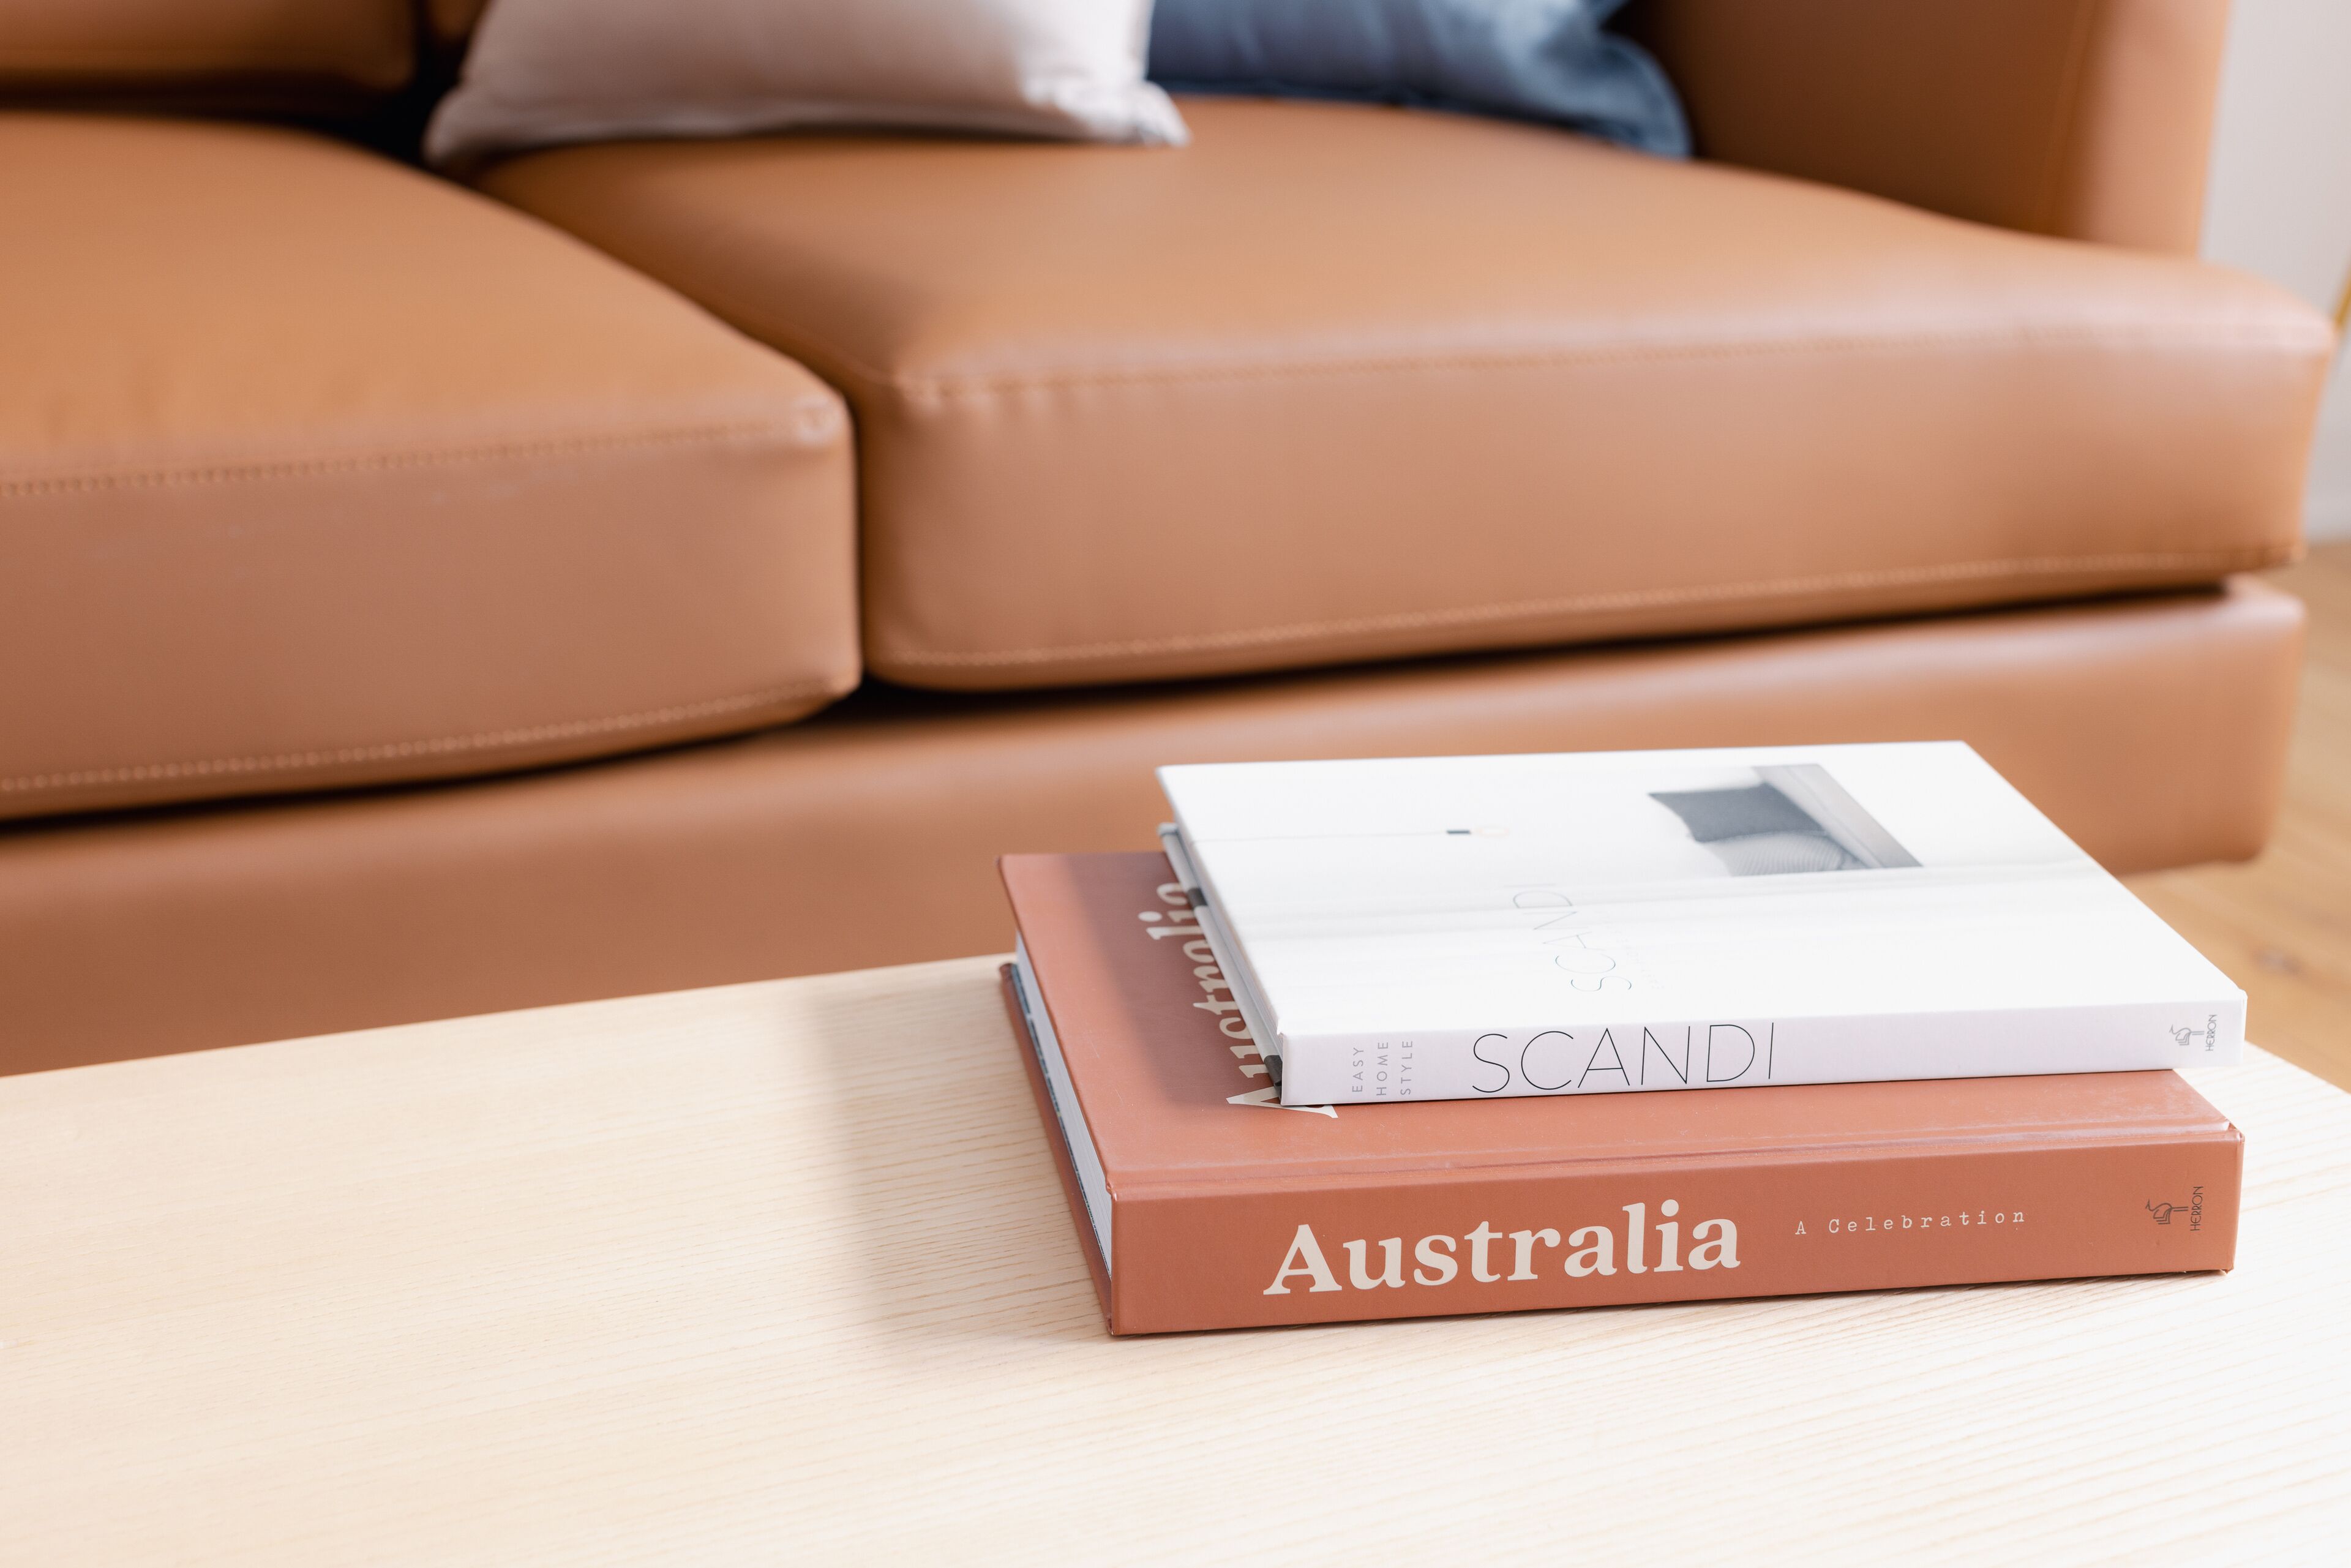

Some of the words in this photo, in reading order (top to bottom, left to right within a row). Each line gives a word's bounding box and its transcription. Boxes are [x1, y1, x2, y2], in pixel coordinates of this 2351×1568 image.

[1472, 1022, 1774, 1093] SCANDI
[2205, 1014, 2218, 1051] HERRON
[1352, 1047, 1364, 1092] EASY
[1376, 1041, 1389, 1096] HOME
[1400, 1040, 1413, 1095] STYLE
[1794, 1220, 1807, 1235] A
[1828, 1210, 2025, 1234] Celebration
[2189, 1186, 2203, 1231] HERRON
[1263, 1199, 1741, 1296] Australia
